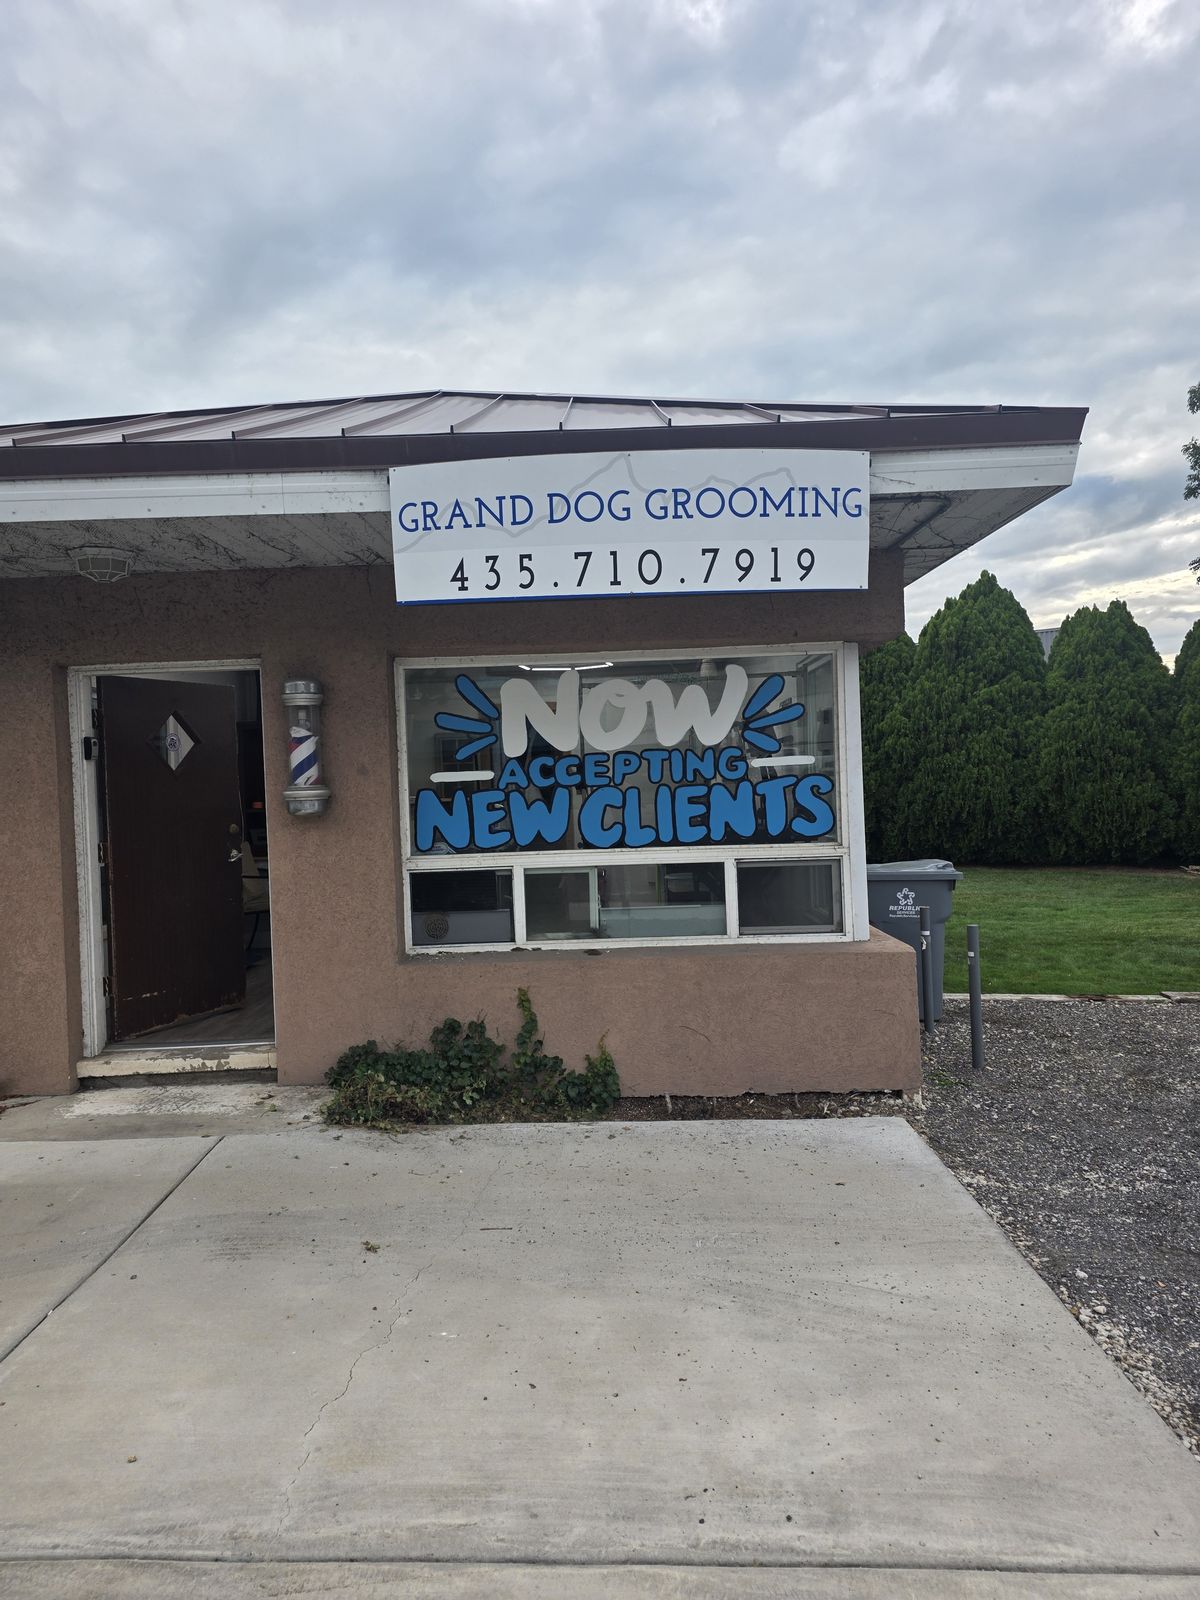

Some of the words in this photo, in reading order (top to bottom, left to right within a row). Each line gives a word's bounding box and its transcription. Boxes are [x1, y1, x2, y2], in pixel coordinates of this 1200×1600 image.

[399, 494, 534, 533] GRAND
[547, 490, 631, 524] DOG
[645, 486, 863, 520] GROOMING
[450, 547, 816, 592] 435.710.7919
[500, 664, 748, 757] NOW
[498, 747, 748, 789] ACCEPTING
[415, 786, 571, 852] NEW
[578, 773, 836, 848] CLIENTS
